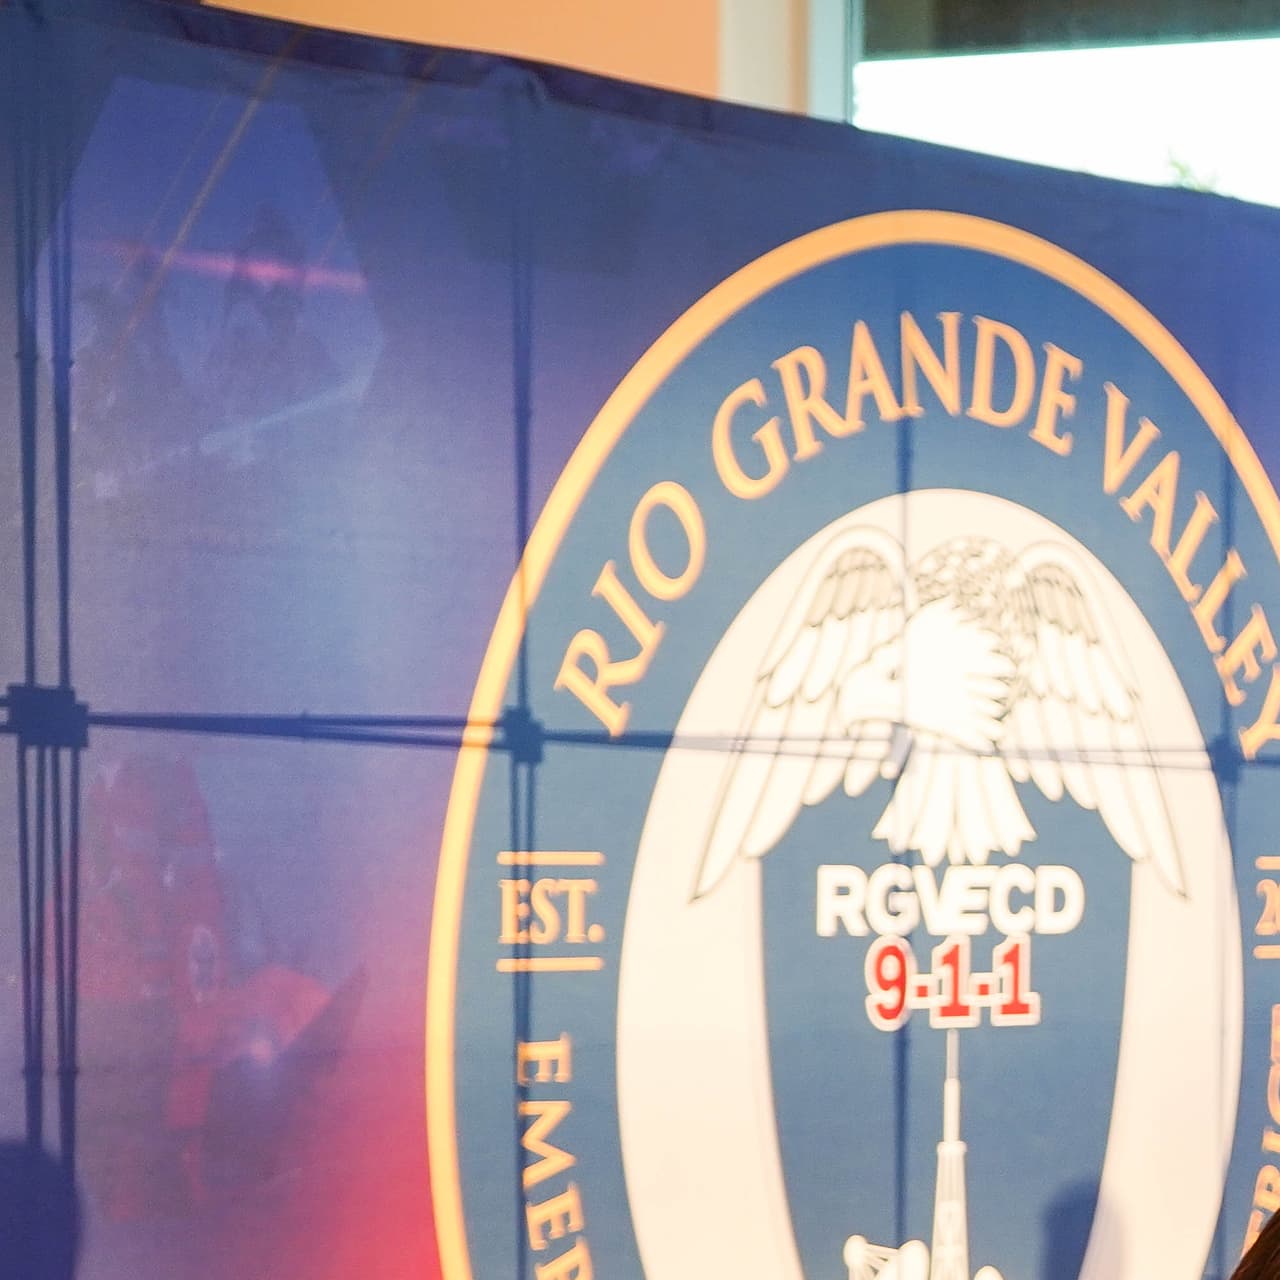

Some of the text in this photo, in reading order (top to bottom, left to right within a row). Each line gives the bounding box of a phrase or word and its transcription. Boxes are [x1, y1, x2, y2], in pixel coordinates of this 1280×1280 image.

[554, 481, 707, 737] RIO
[712, 311, 1082, 500] GRANDE
[498, 878, 606, 945] EST.
[816, 863, 1085, 937] RGVECD
